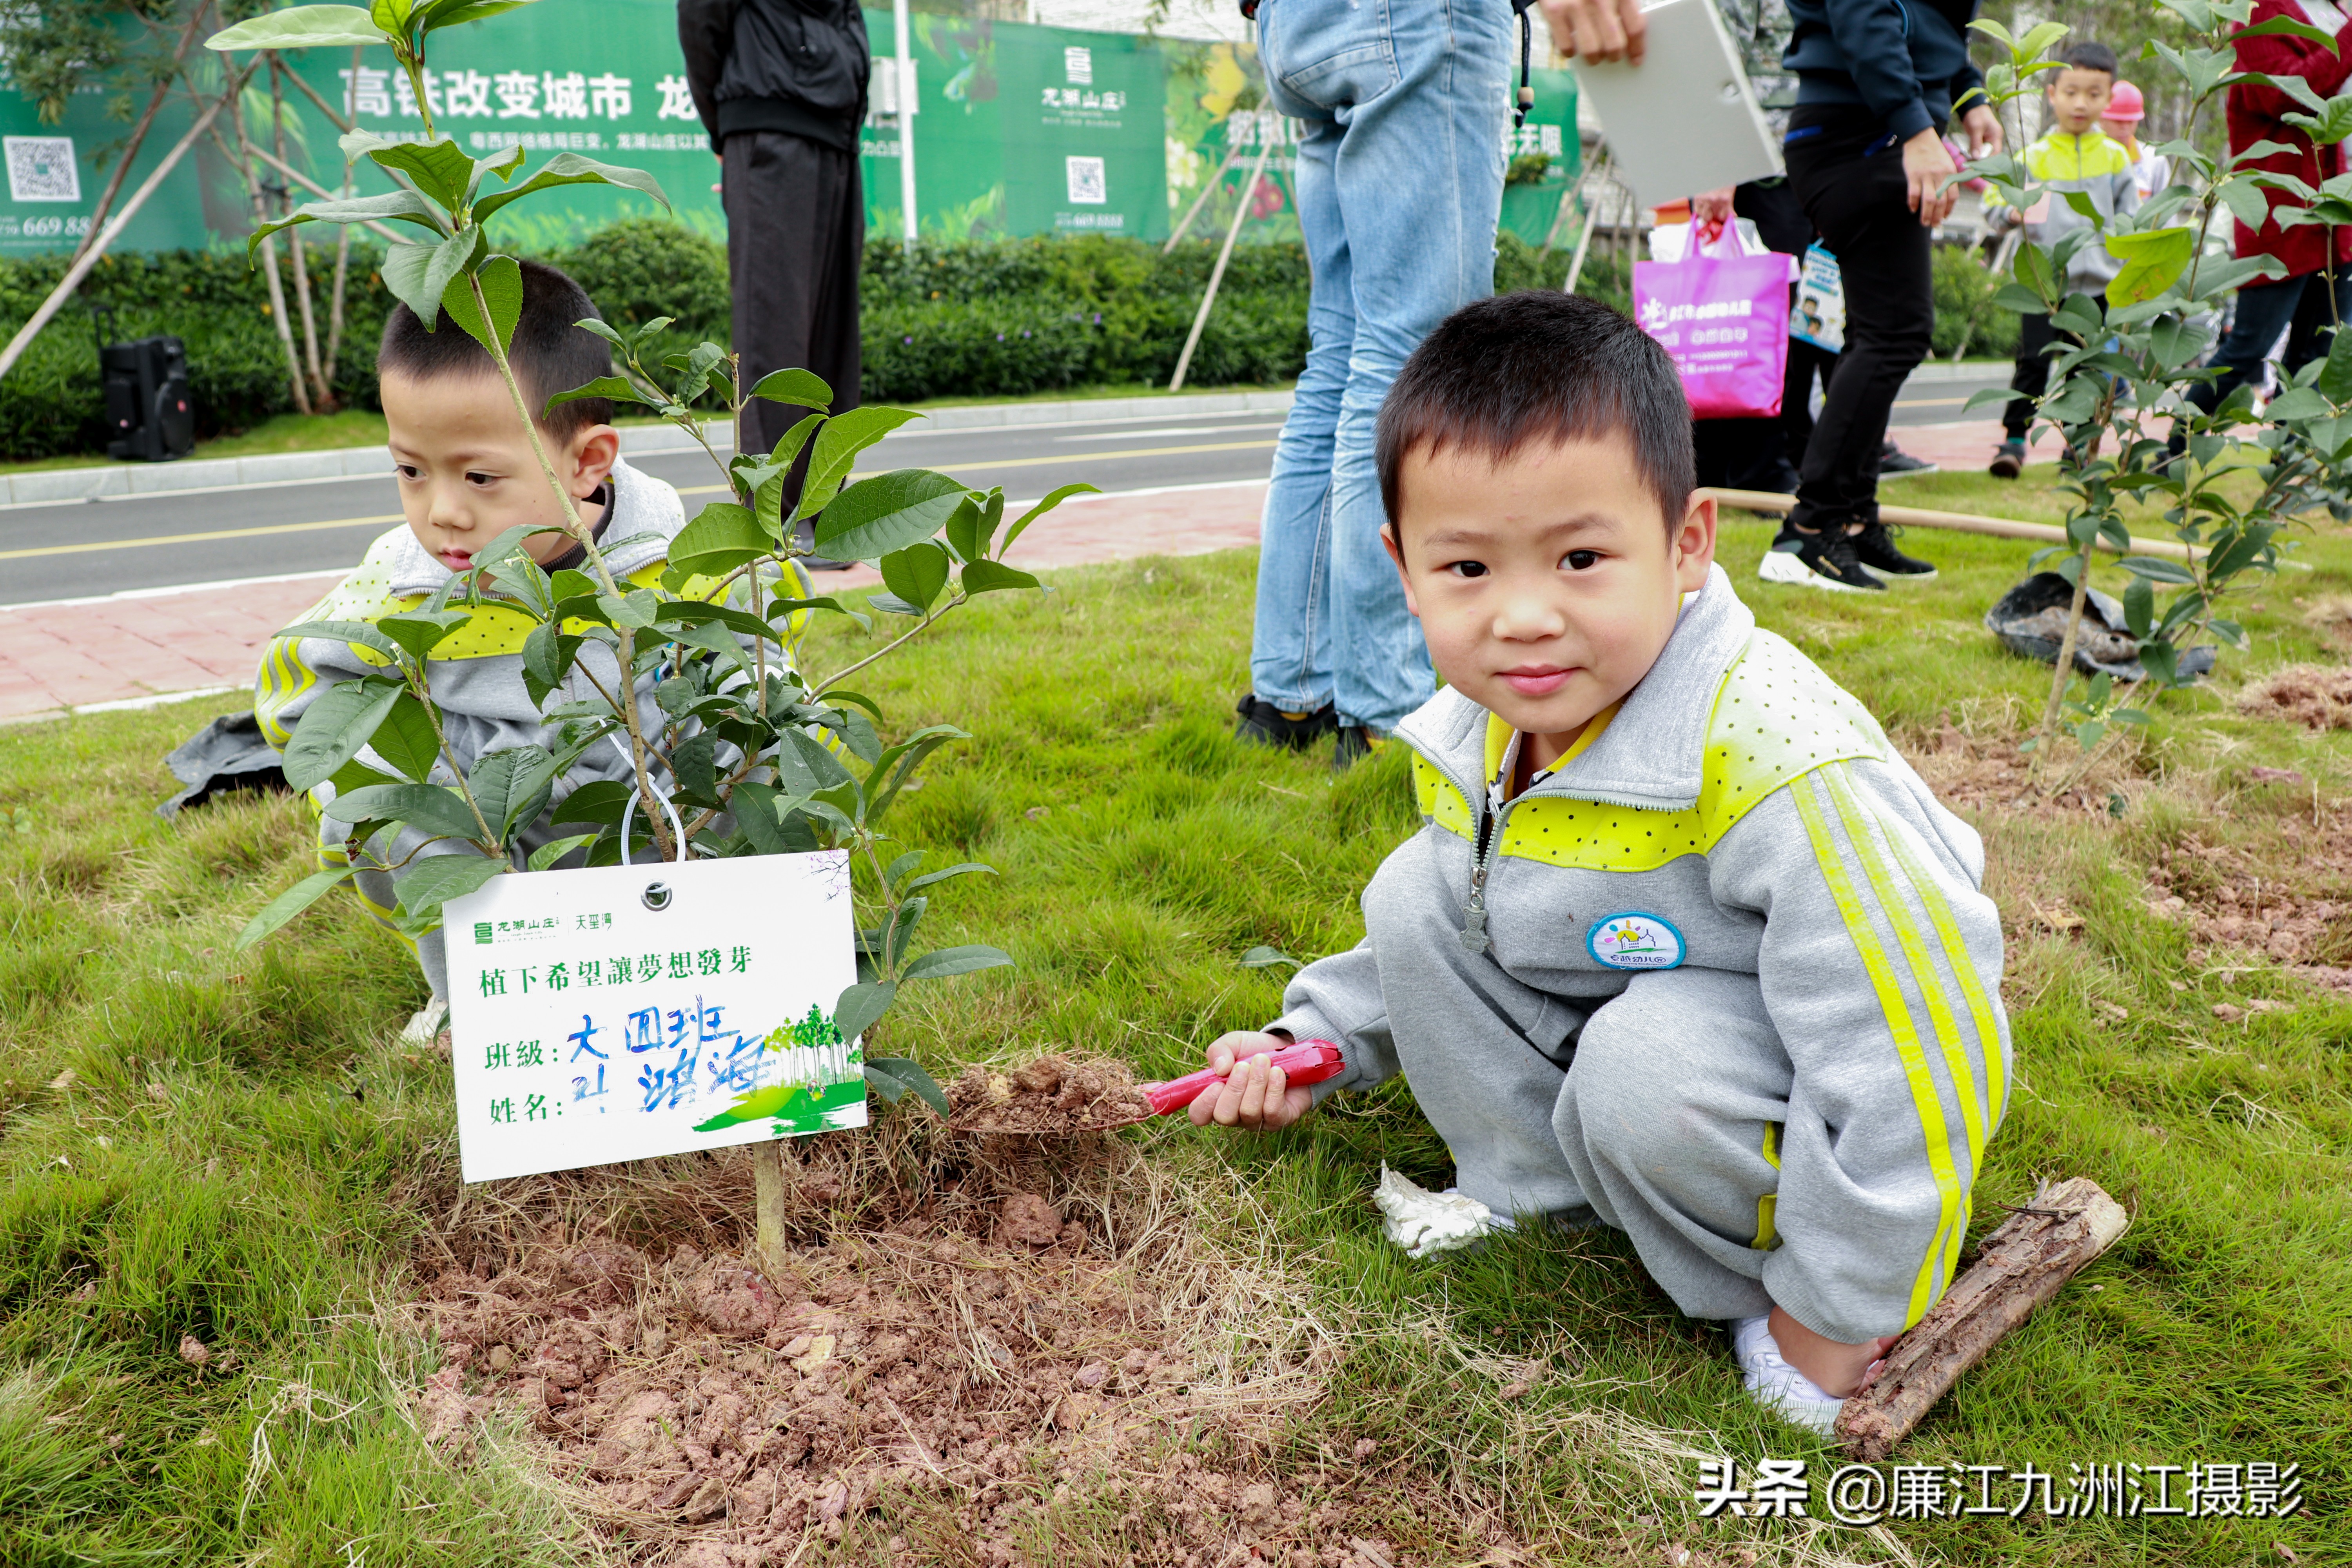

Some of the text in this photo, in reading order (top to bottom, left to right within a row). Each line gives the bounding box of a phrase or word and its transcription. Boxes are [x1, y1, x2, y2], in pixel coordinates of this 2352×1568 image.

[338, 66, 632, 120] 高铁改变城市
[22, 216, 63, 237] 669
[497, 918, 555, 932] 龙湖山庄
[576, 913, 612, 931] 天玺湾
[478, 946, 752, 998] 植下希望讓夢想發芽
